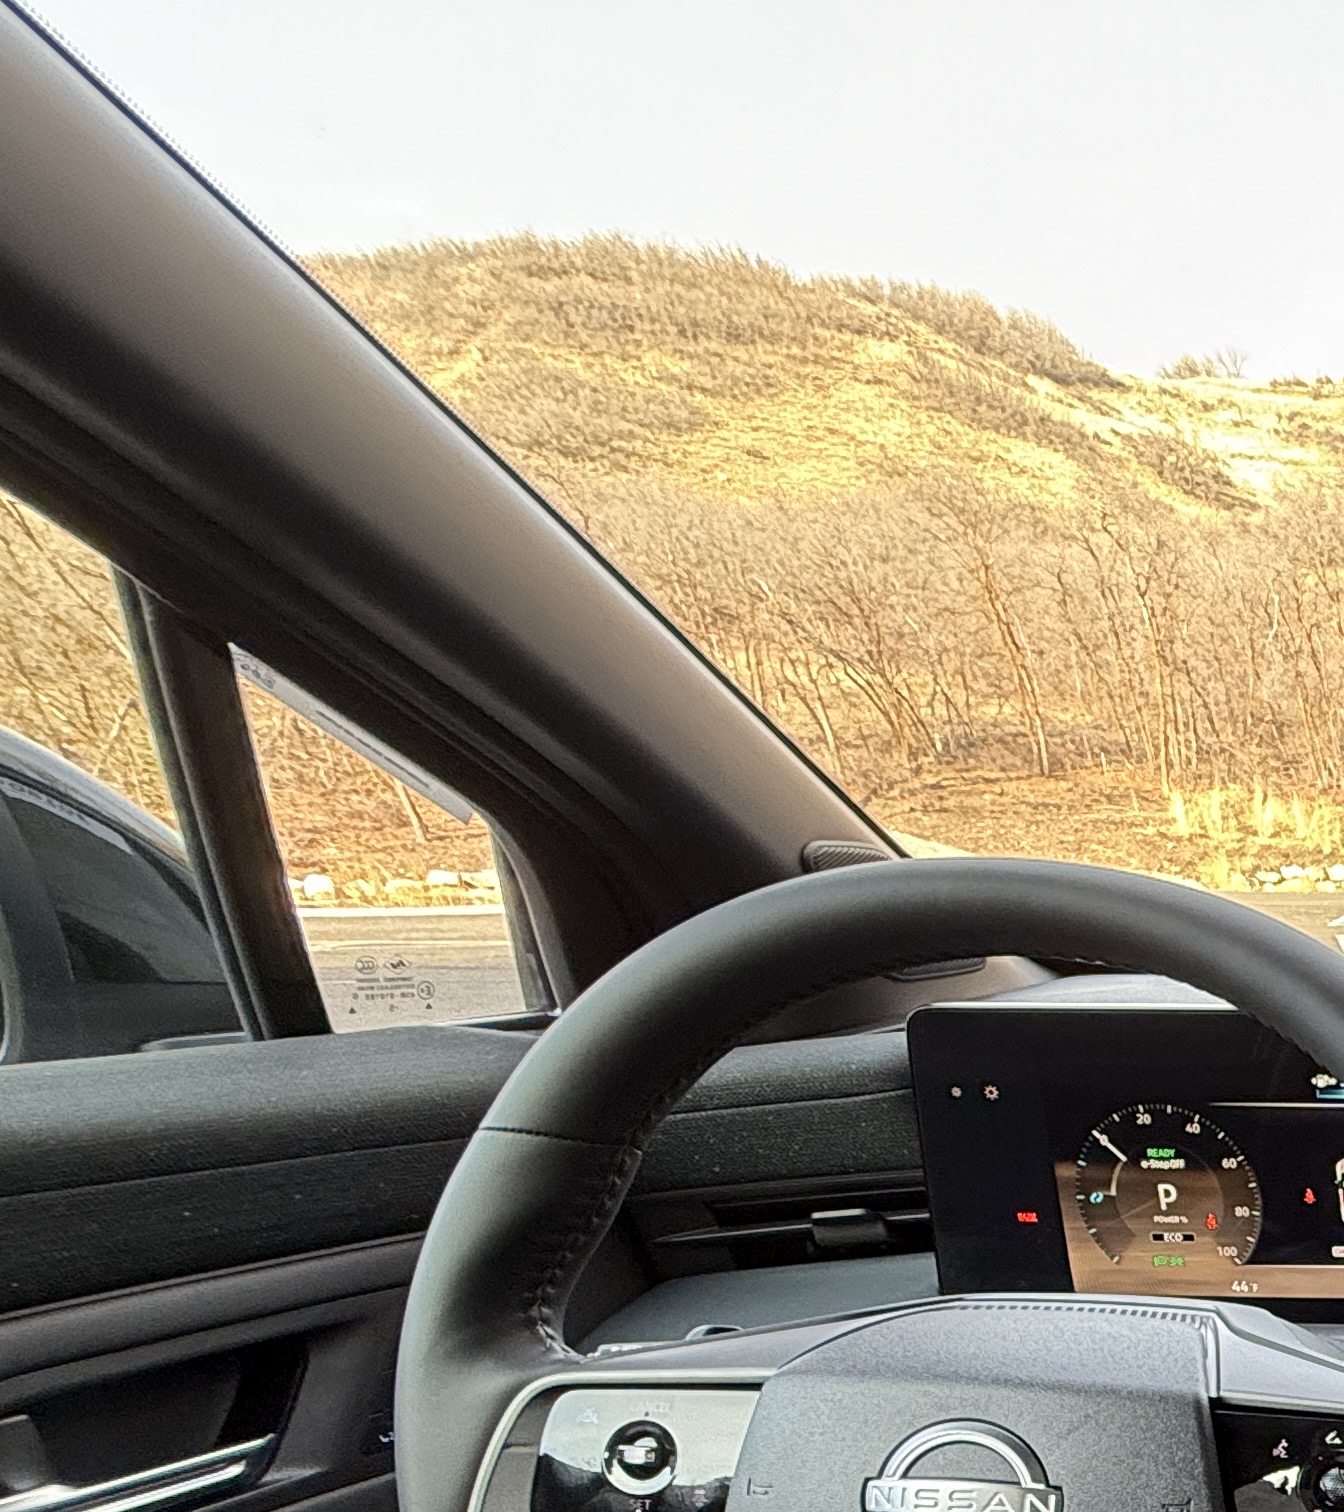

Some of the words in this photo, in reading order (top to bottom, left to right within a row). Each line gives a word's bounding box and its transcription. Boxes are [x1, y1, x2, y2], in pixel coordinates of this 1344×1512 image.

[1136, 1113, 1151, 1125] 20
[1185, 1123, 1200, 1134] 40
[1146, 1148, 1175, 1157] READY
[1221, 1158, 1237, 1169] 60
[1157, 1183, 1177, 1211] P
[1234, 1206, 1250, 1218] 80
[1163, 1232, 1183, 1242] ECO
[1217, 1246, 1237, 1257] 100
[629, 1499, 652, 1511] SET
